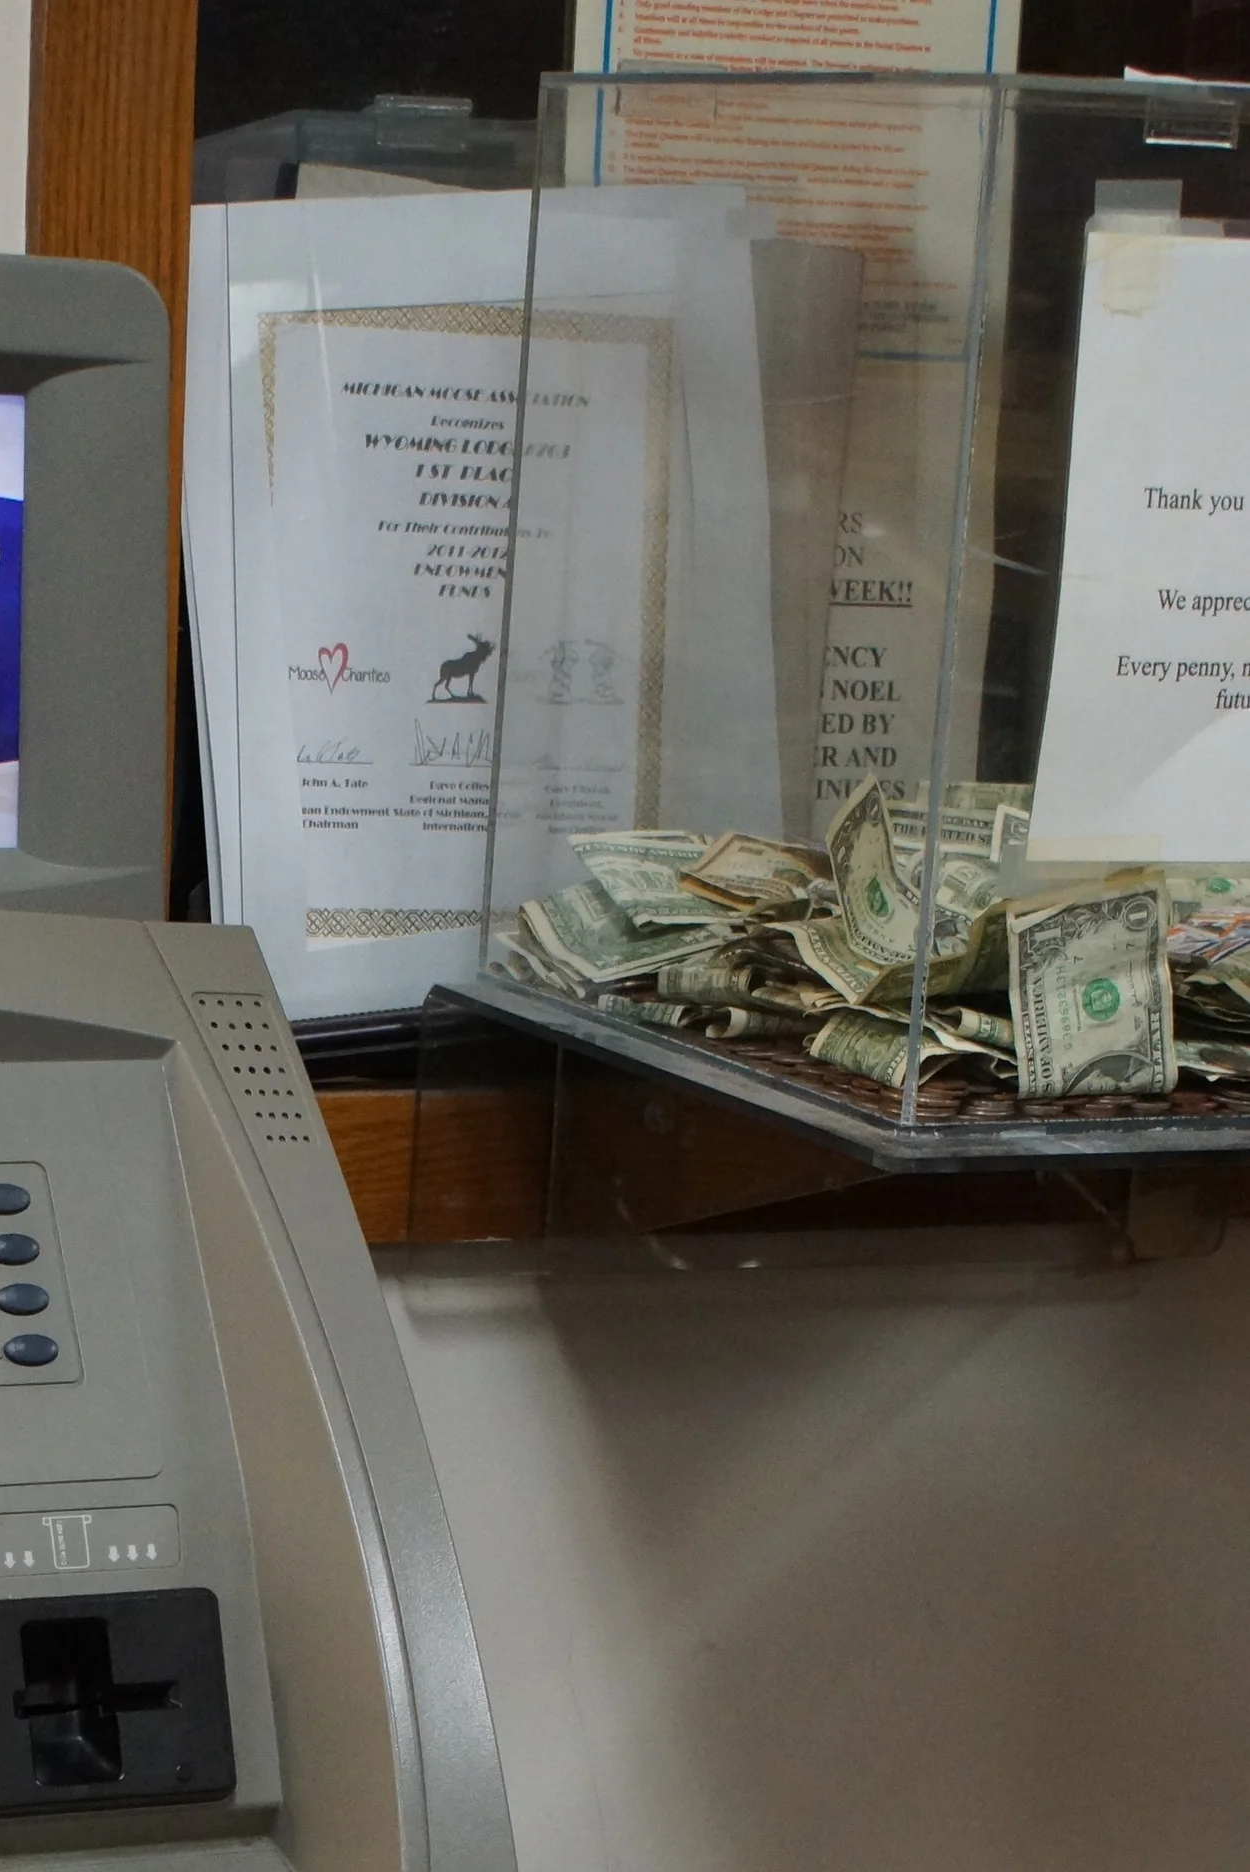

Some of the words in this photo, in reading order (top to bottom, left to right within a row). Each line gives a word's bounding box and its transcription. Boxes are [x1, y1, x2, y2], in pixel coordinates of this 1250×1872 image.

[364, 433, 457, 454] WYOMING
[461, 439, 518, 457] LODG
[459, 465, 517, 482] PLAC
[419, 491, 501, 509] DIVISION
[1144, 487, 1203, 510] Thank
[1207, 494, 1245, 517] you
[1158, 589, 1187, 611] We
[1116, 655, 1171, 683] Every
[1175, 661, 1235, 683] penny,
[829, 680, 902, 702] NOEL
[861, 713, 896, 735] BY
[844, 746, 897, 769] AND
[1031, 976, 1051, 1053] AMERICA
